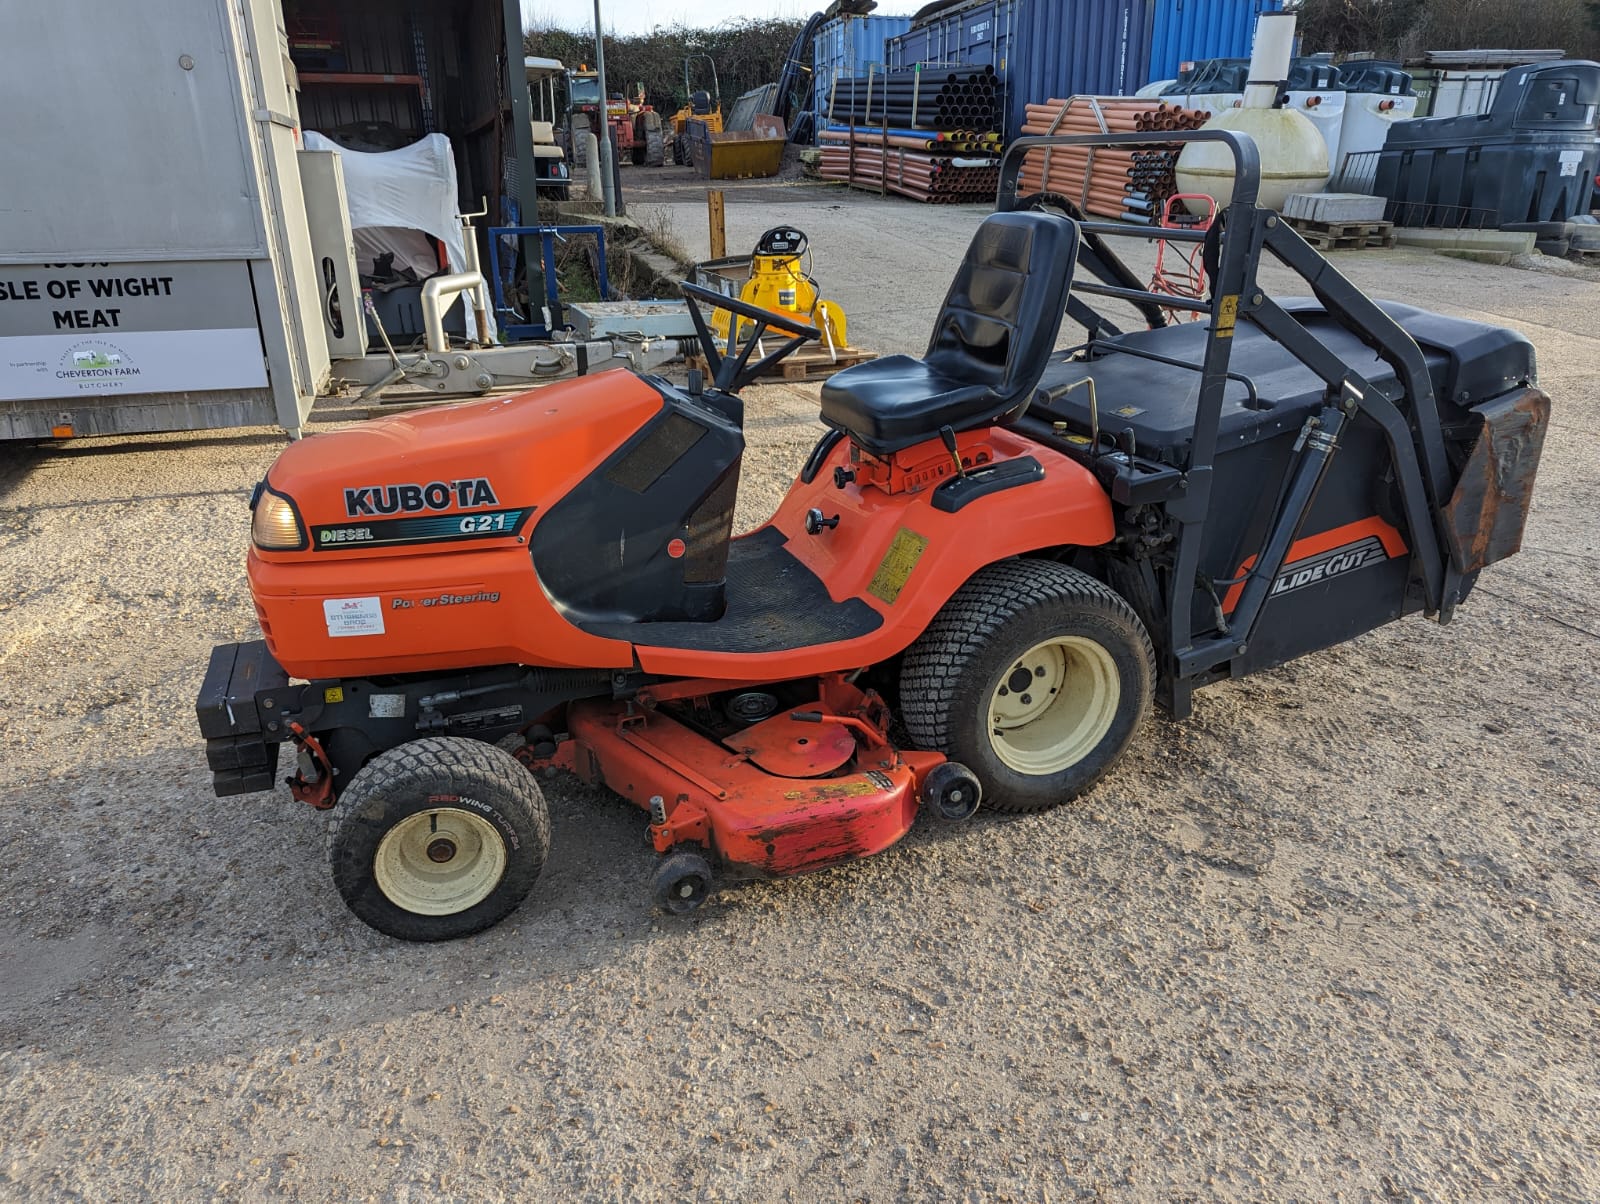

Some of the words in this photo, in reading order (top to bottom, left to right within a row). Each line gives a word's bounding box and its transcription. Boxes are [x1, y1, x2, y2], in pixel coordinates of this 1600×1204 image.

[46, 280, 82, 299] OF
[88, 277, 173, 298] WIGHT
[52, 309, 121, 329] MEAT
[56, 368, 112, 379] CHEVERTON
[115, 367, 141, 376] FARM
[344, 477, 499, 517] KUBOTA
[460, 513, 506, 533] G21
[320, 527, 374, 543] DIESEL
